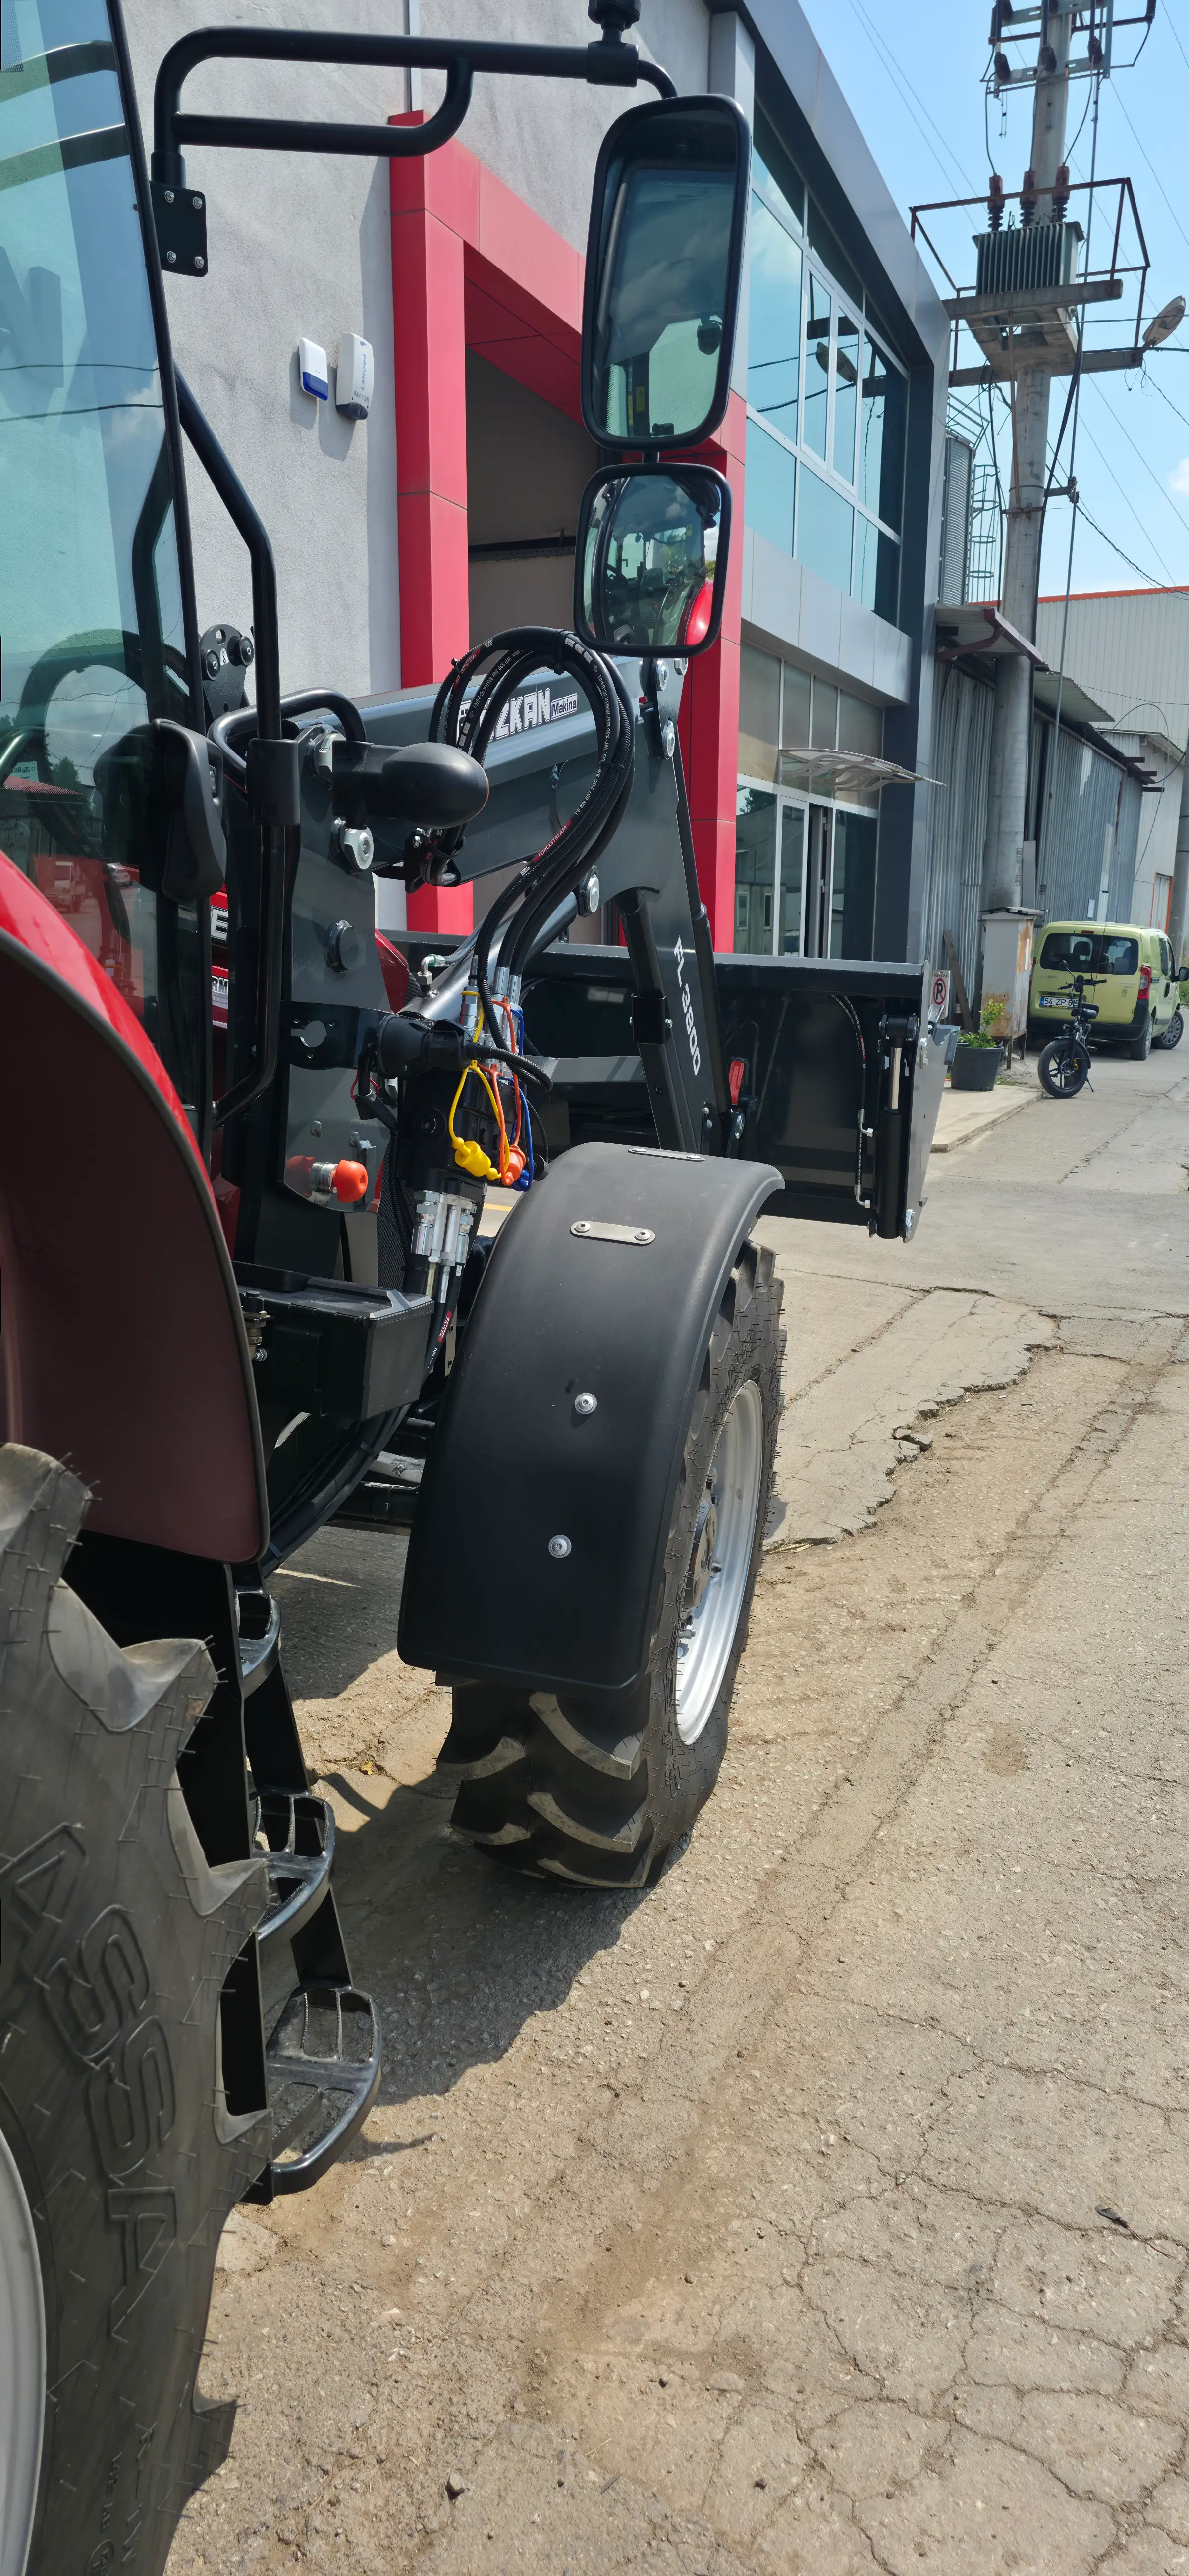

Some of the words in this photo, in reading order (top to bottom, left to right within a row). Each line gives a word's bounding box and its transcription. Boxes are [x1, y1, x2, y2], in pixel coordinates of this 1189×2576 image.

[504, 656, 512, 664] WP
[483, 676, 494, 691] MSHA
[598, 675, 607, 697] IC-84/41
[480, 688, 551, 742] ZKAN
[552, 698, 577, 716] Makina
[604, 740, 609, 750] WP
[579, 800, 587, 808] EN
[574, 808, 581, 816] TS
[538, 825, 568, 858] FORCESTREAM
[520, 865, 531, 876] SEL
[674, 935, 684, 987] FL
[682, 983, 701, 1075] 3800
[1044, 997, 1053, 1005] 54
